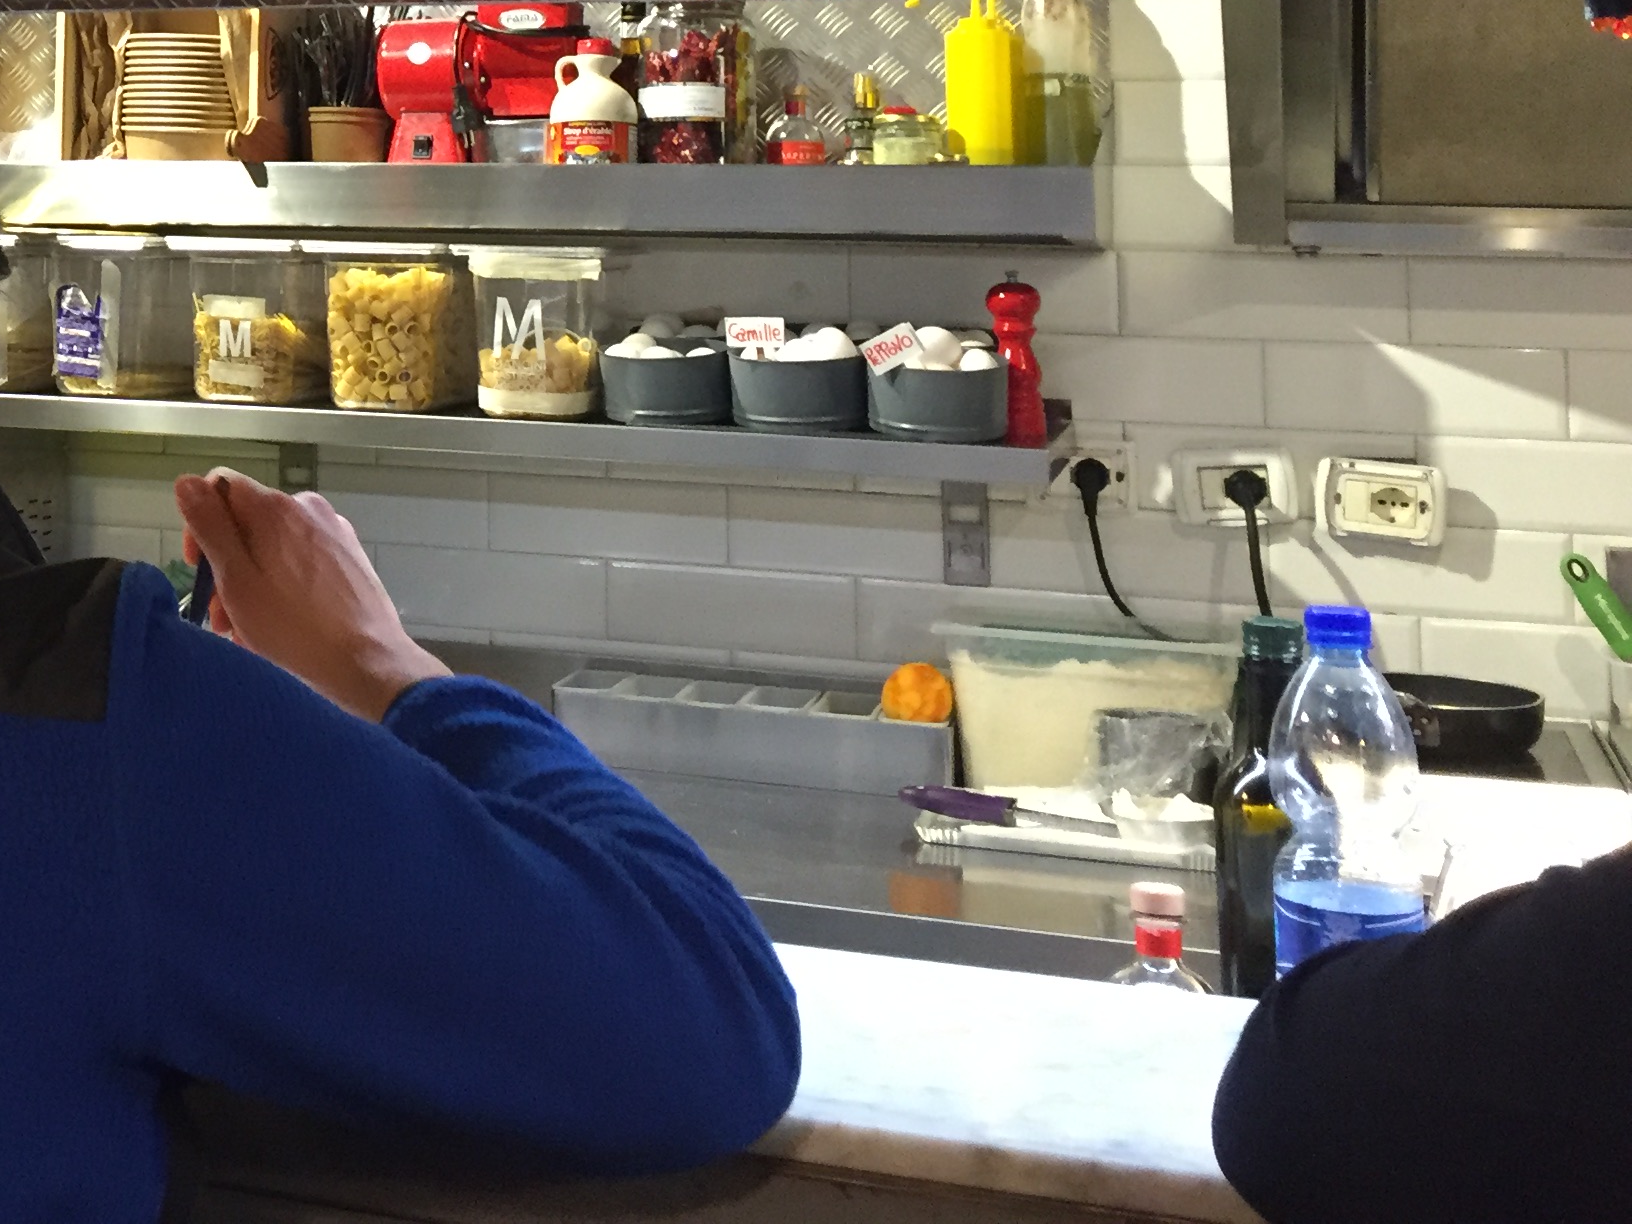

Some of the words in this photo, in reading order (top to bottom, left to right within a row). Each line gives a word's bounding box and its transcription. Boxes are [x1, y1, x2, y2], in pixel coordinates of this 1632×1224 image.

[219, 319, 262, 358] M
[492, 296, 546, 360] M
[728, 322, 783, 344] Camille
